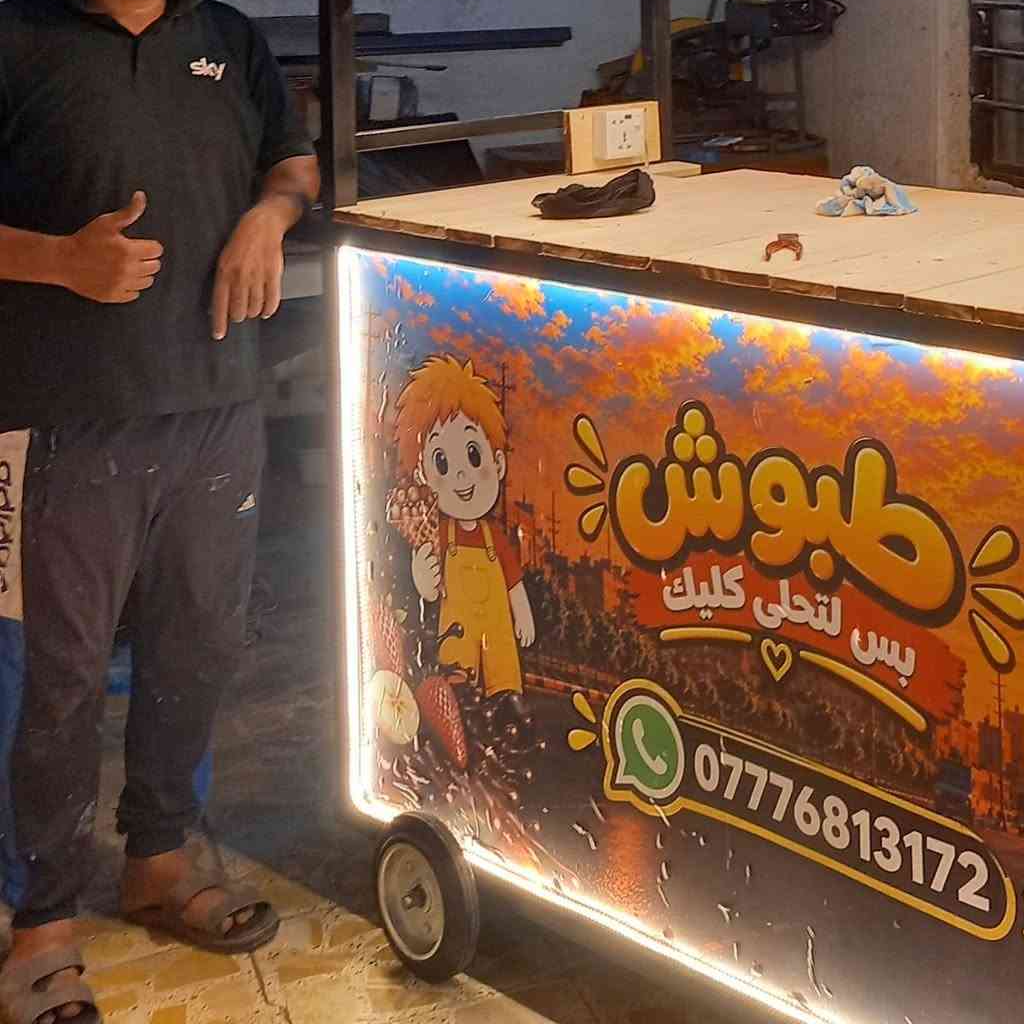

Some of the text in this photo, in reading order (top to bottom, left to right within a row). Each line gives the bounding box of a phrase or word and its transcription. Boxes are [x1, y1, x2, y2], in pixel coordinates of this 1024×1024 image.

[190, 57, 226, 81] sky
[609, 400, 966, 629] طبوش
[662, 564, 745, 620] كليك
[850, 626, 916, 688] بس
[694, 743, 990, 913] 07776813172
